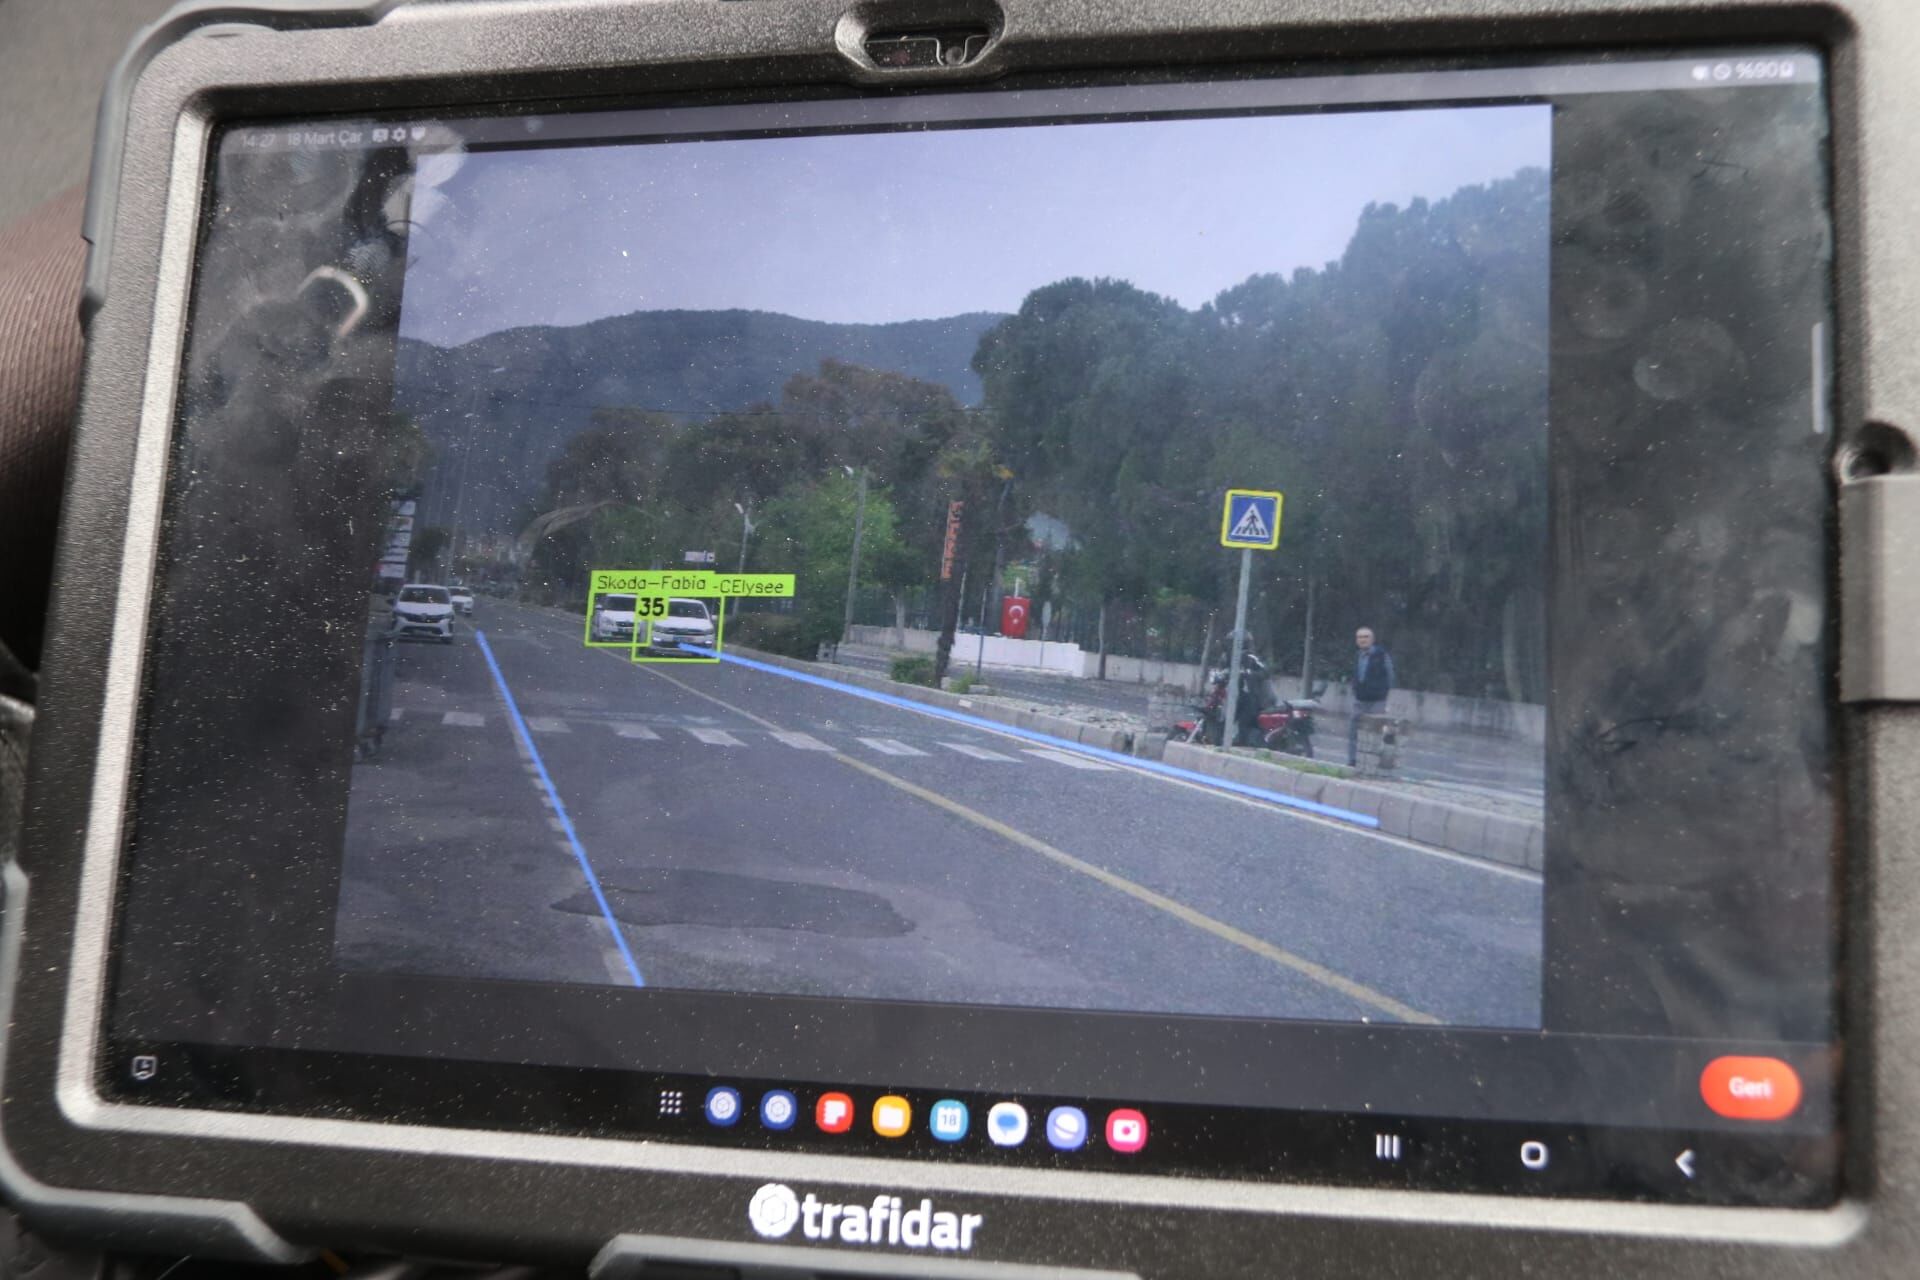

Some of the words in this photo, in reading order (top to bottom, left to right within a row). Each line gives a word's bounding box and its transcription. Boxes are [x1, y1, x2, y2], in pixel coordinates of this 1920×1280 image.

[287, 133, 301, 146] 18
[304, 131, 336, 146] Mart
[338, 130, 362, 147] Çar
[638, 597, 665, 617] 35
[1728, 1076, 1771, 1099] Geri
[942, 1114, 957, 1126] 18
[801, 1191, 982, 1251] trafidar
